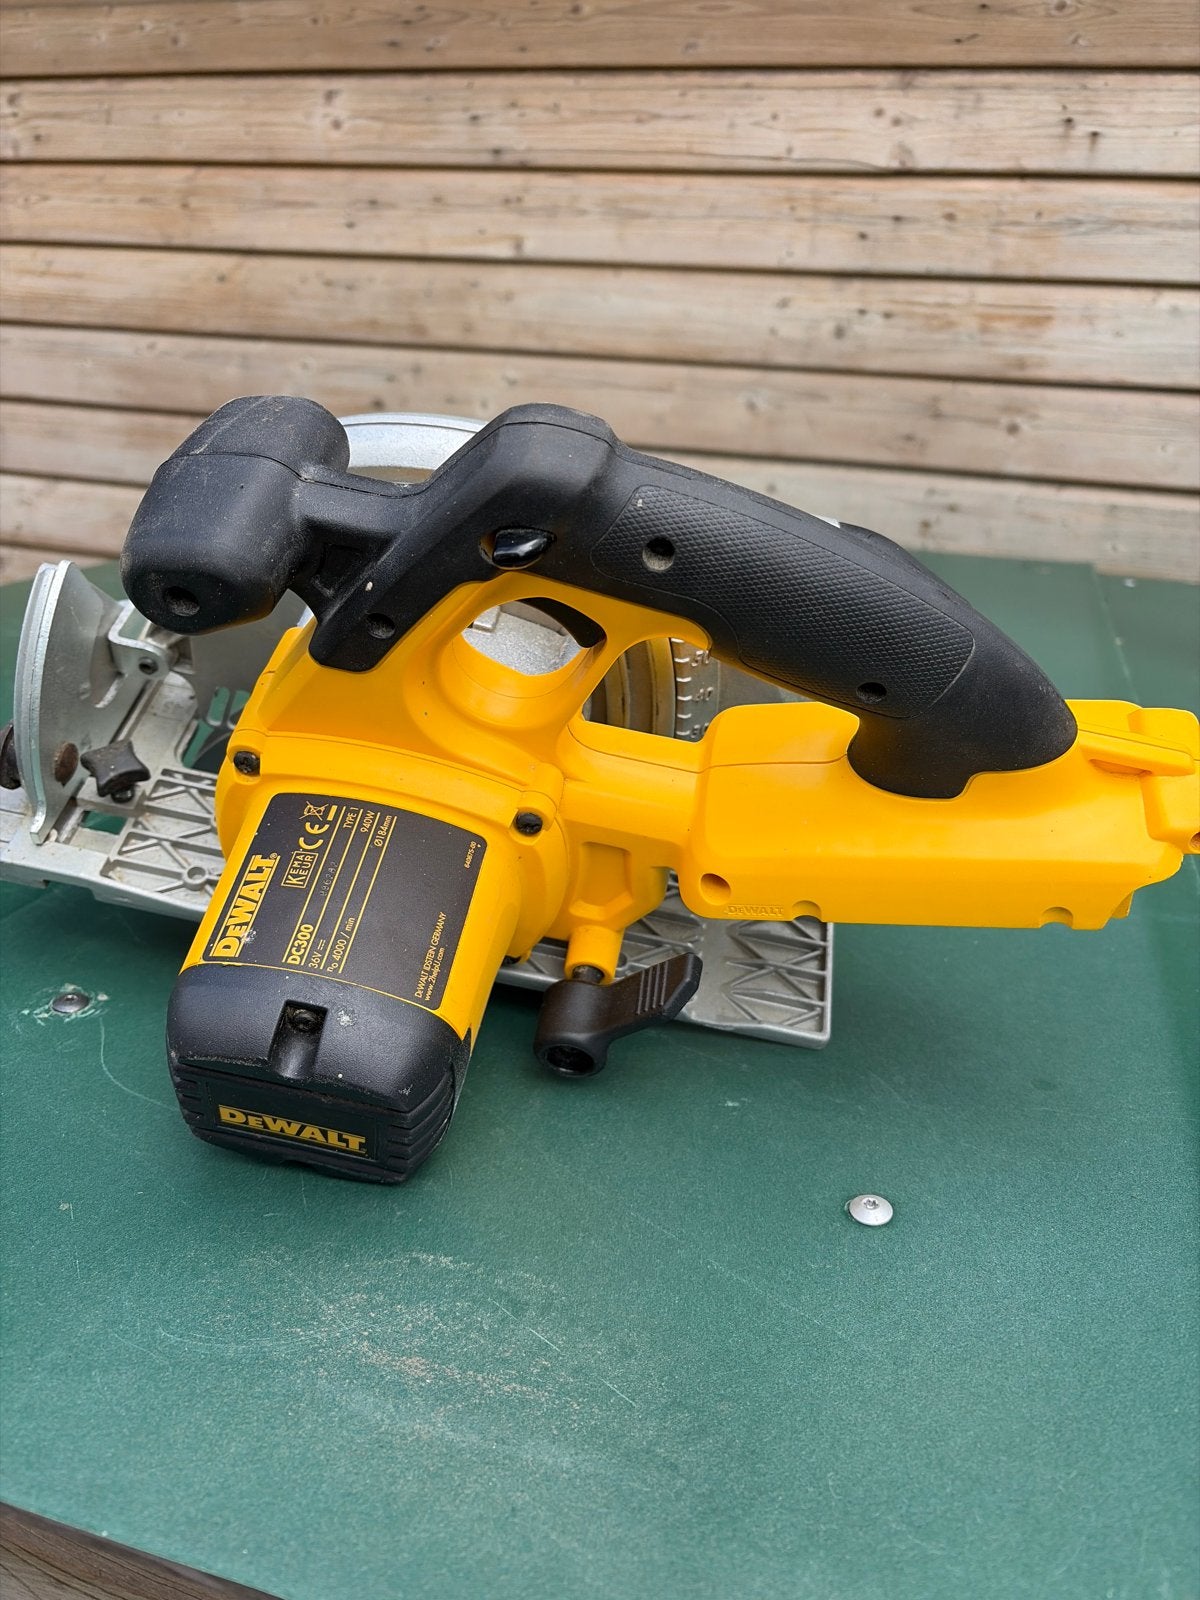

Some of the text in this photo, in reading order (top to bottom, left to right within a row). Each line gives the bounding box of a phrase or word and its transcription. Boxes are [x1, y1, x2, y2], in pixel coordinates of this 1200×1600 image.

[287, 923, 314, 965] DC300
[342, 812, 358, 829] TYPE
[308, 810, 376, 969] 36V 940W
[335, 939, 347, 961] 4000
[344, 917, 356, 932] min
[422, 945, 437, 971] IDSTEIN
[430, 911, 447, 946] GERMANY
